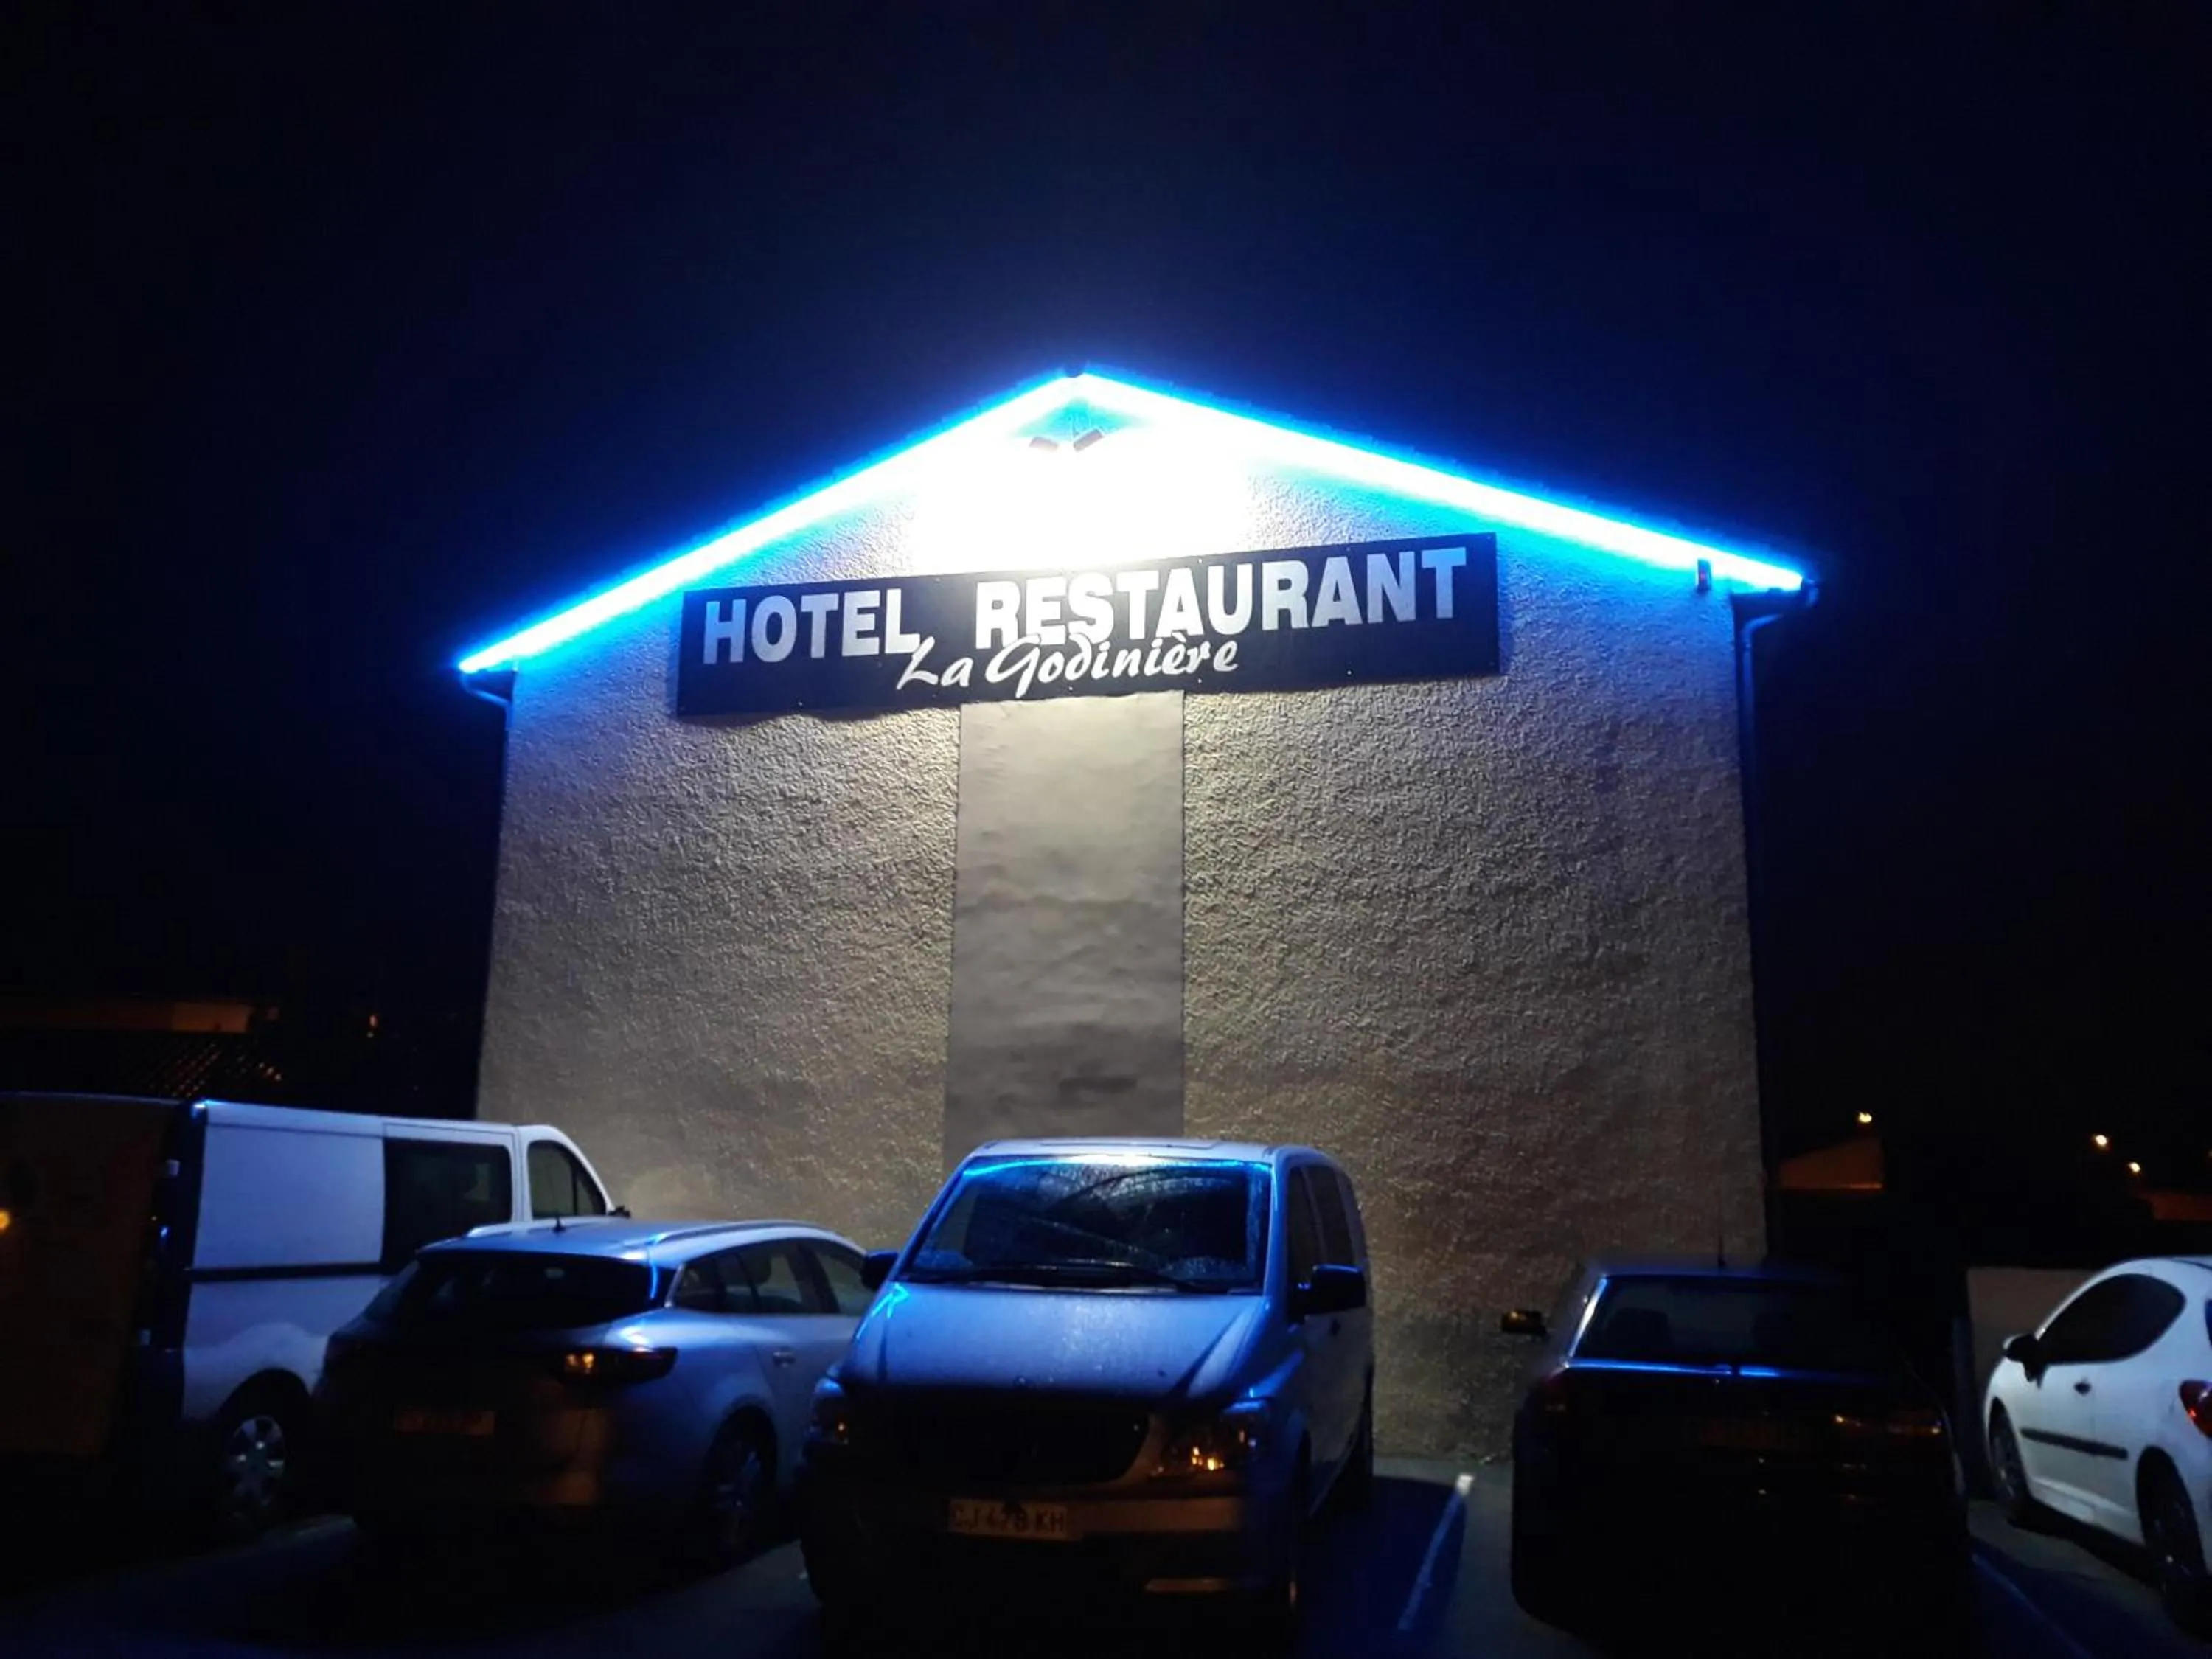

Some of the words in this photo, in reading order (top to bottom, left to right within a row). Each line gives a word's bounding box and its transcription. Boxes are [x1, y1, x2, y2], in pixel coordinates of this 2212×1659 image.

[703, 588, 922, 664] HOTEL
[975, 546, 1467, 650] RESTAURANT
[896, 636, 974, 690] La
[985, 632, 1239, 698] Godinière
